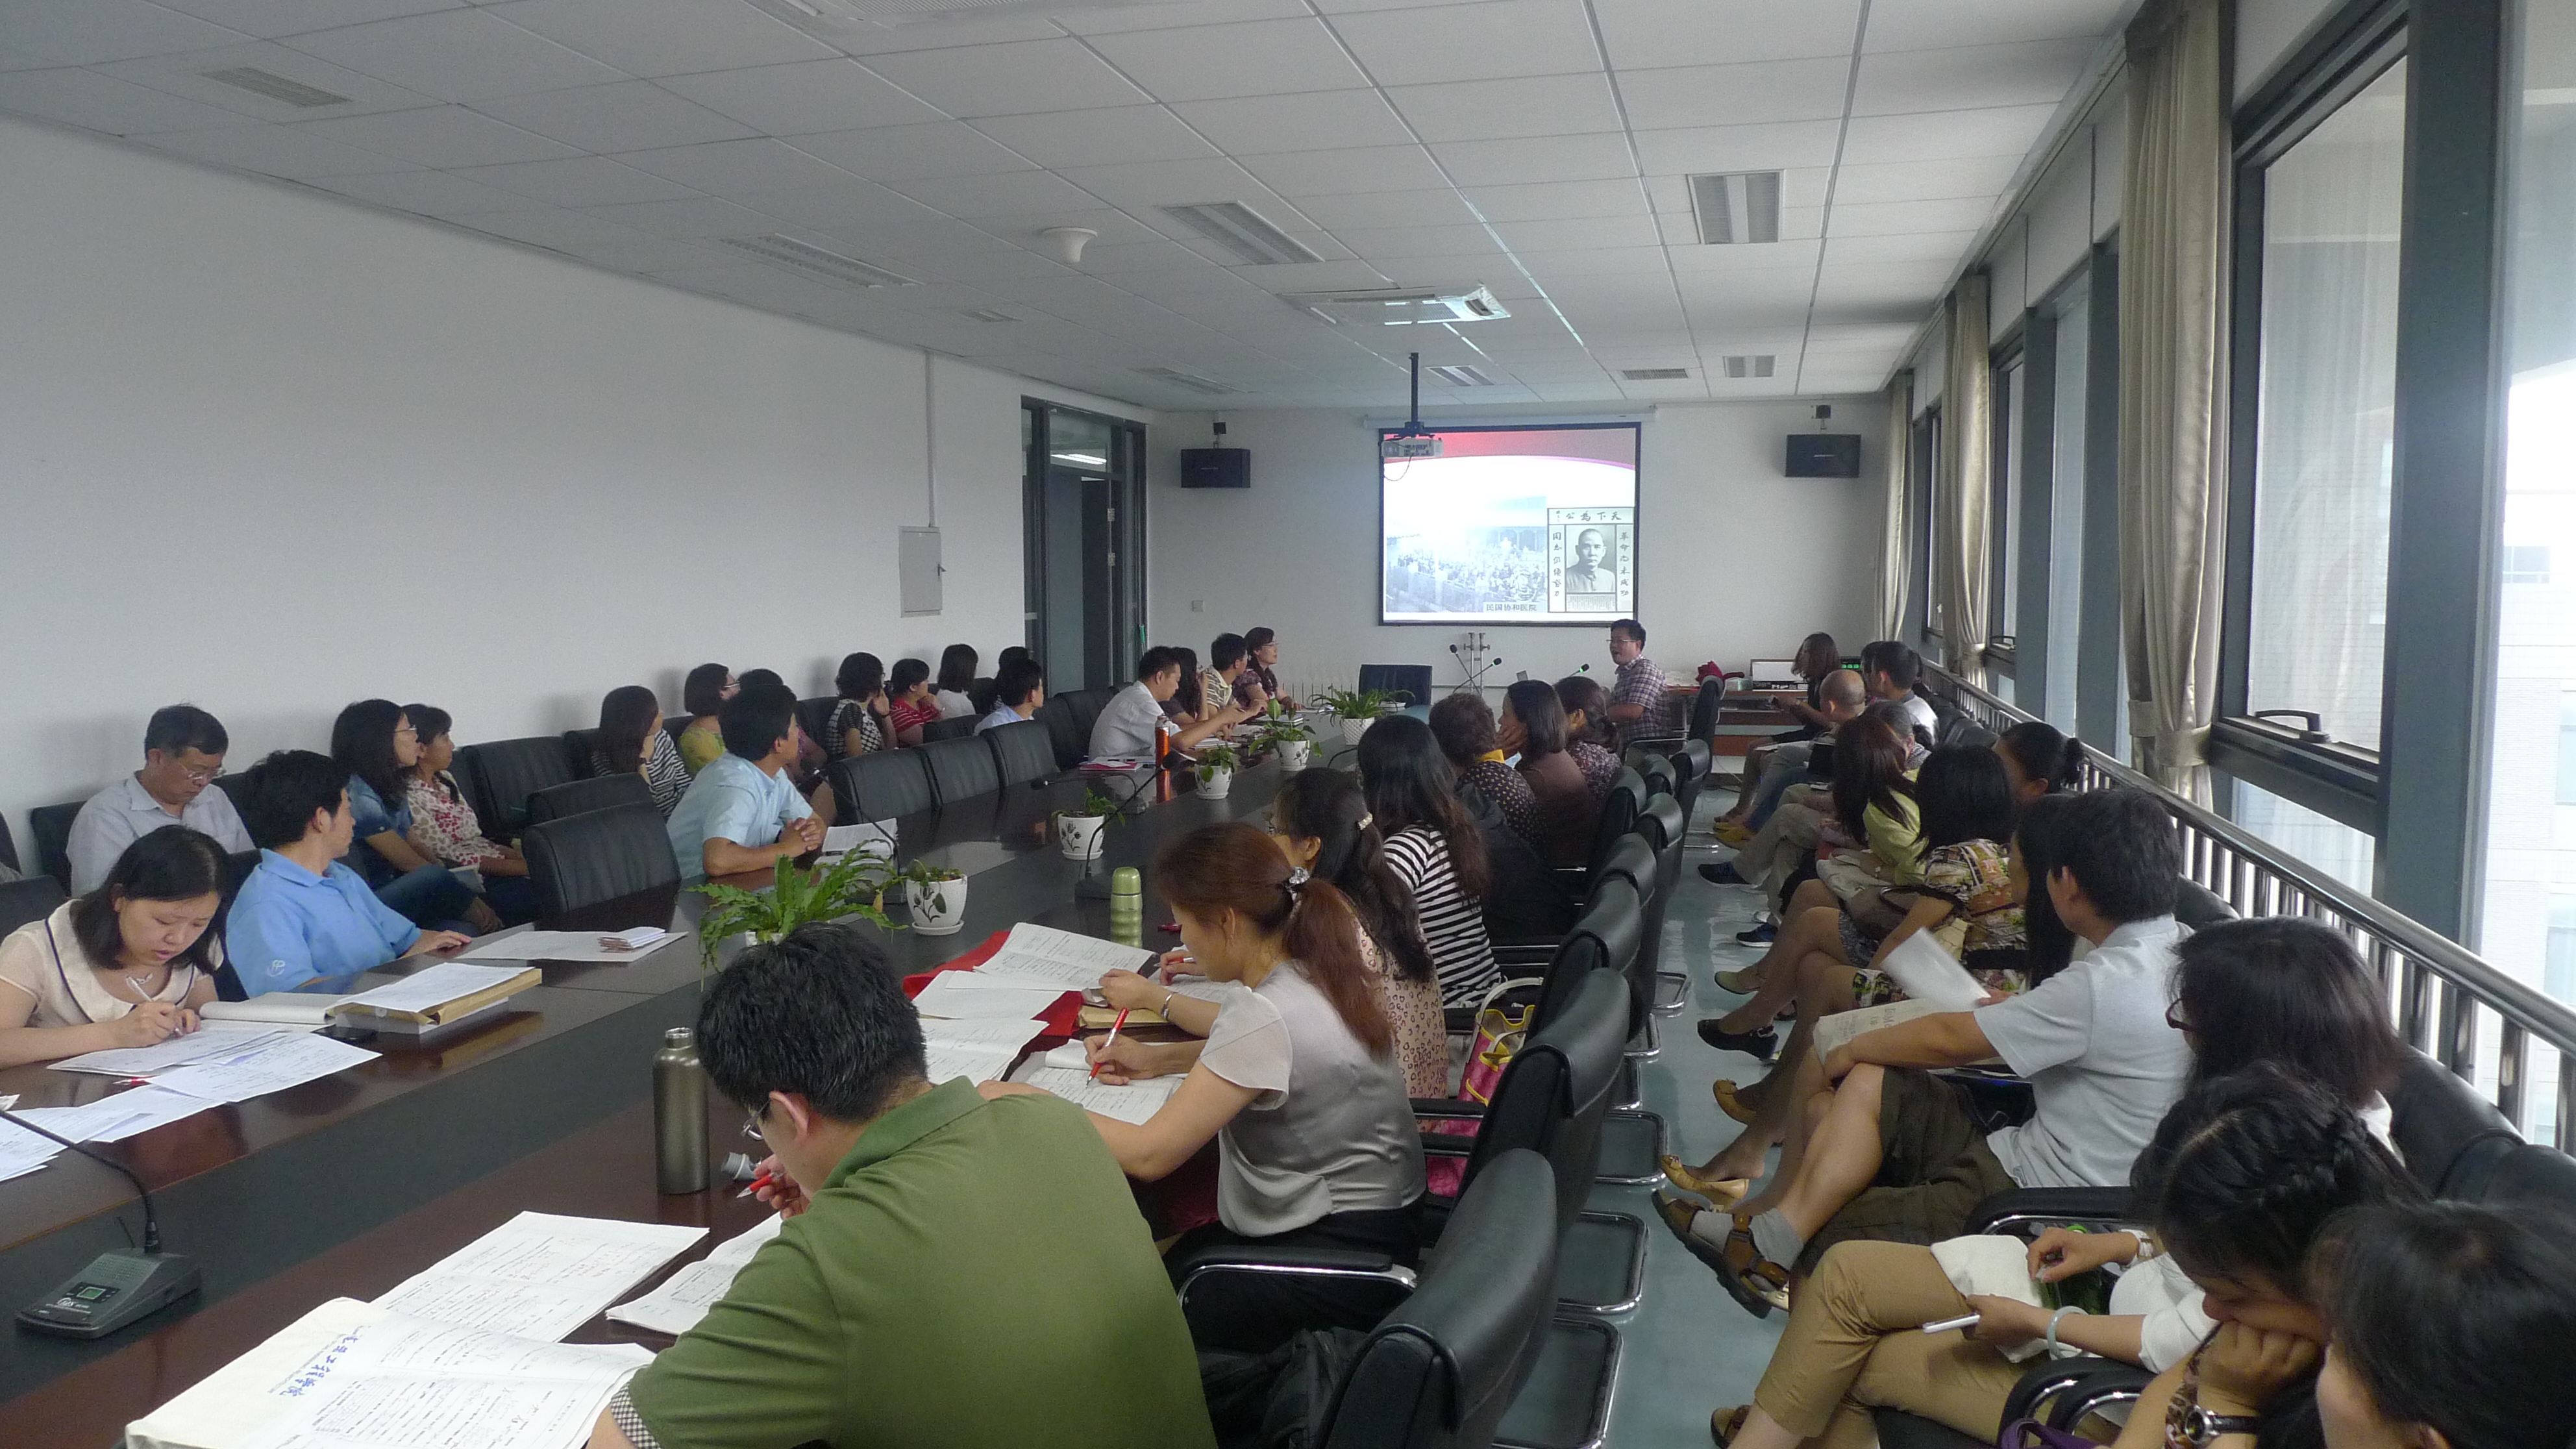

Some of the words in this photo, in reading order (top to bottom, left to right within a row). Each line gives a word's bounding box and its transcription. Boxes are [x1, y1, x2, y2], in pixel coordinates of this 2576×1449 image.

[1486, 603, 1537, 612] 民国协和医院
